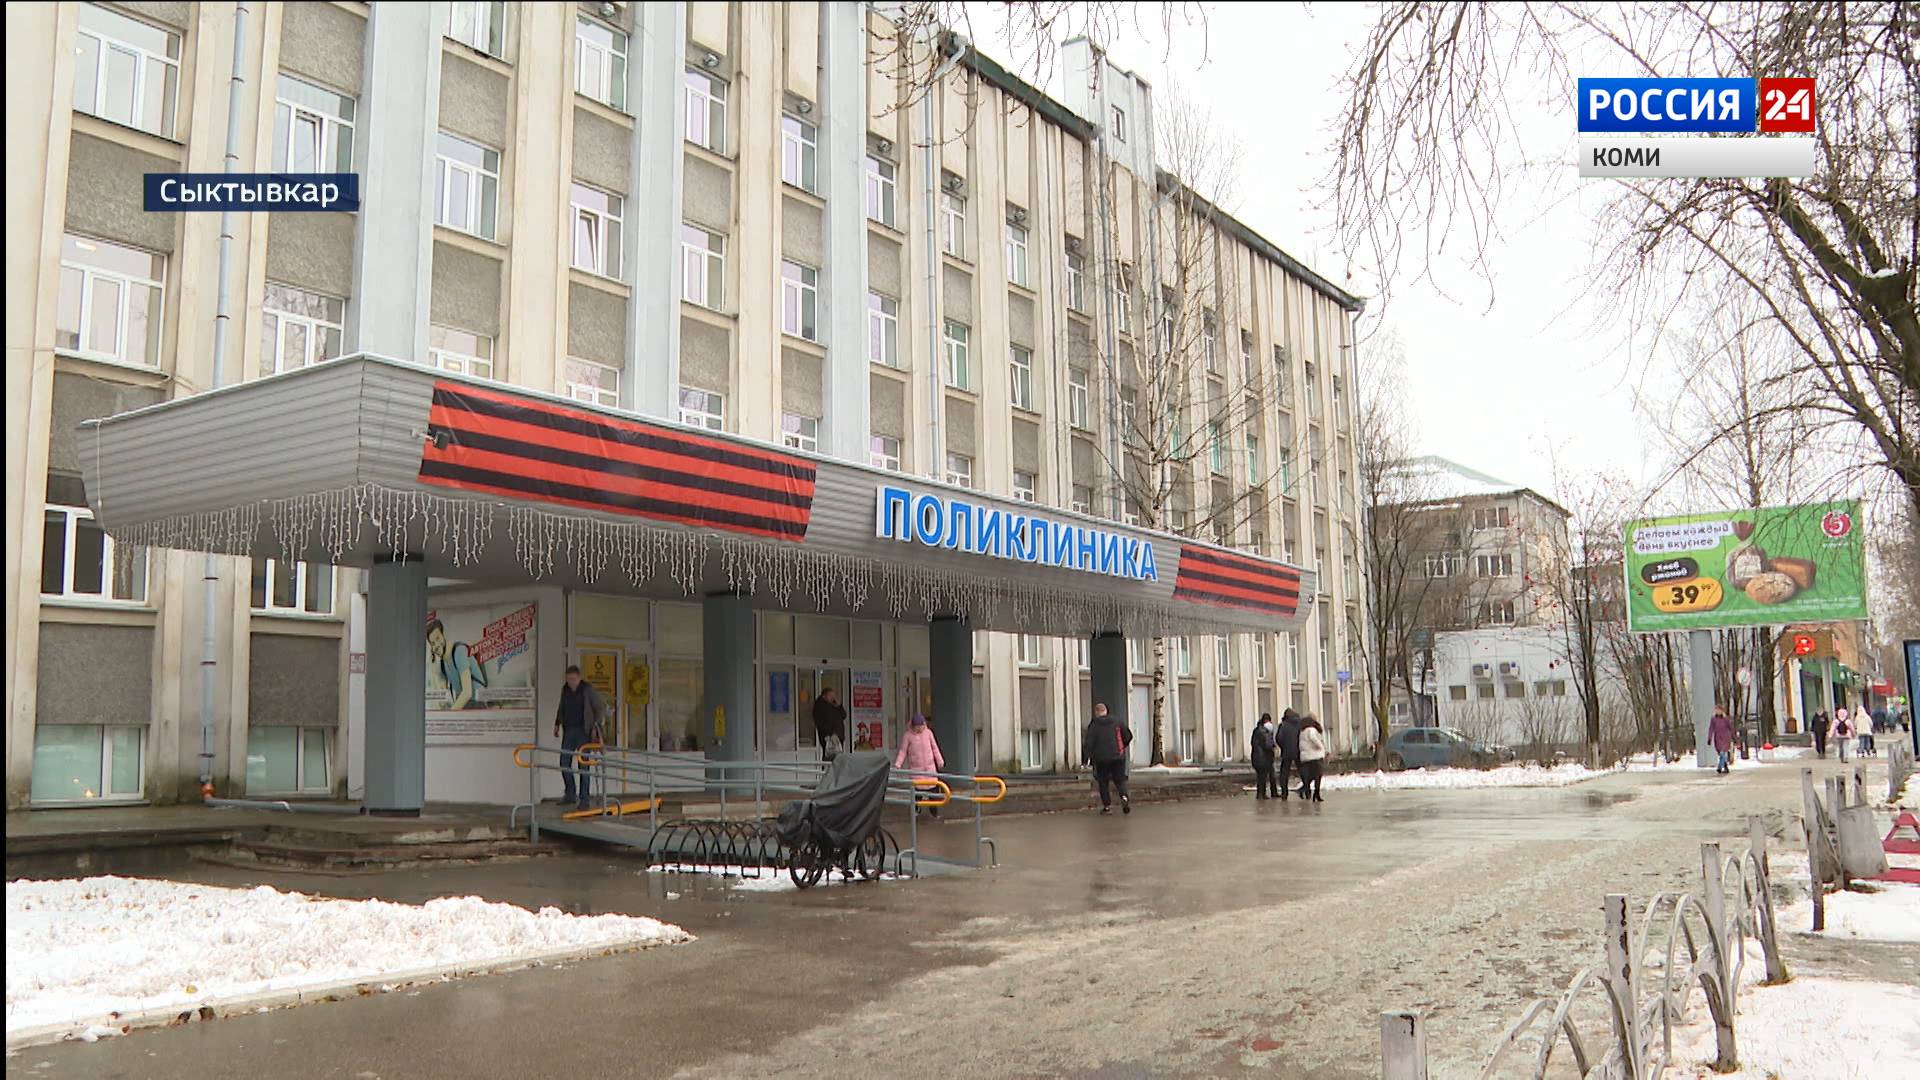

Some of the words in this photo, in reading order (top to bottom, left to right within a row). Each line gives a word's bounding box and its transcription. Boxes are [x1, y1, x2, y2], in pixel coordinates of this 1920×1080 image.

[876, 484, 1158, 582] ПОЛИКЛИНИКА
[1638, 529, 1680, 540] Делаем
[1683, 523, 1729, 536] каждый
[1639, 542, 1664, 551] день
[1668, 539, 1714, 549] вкуснее
[1671, 585, 1699, 604] 39
